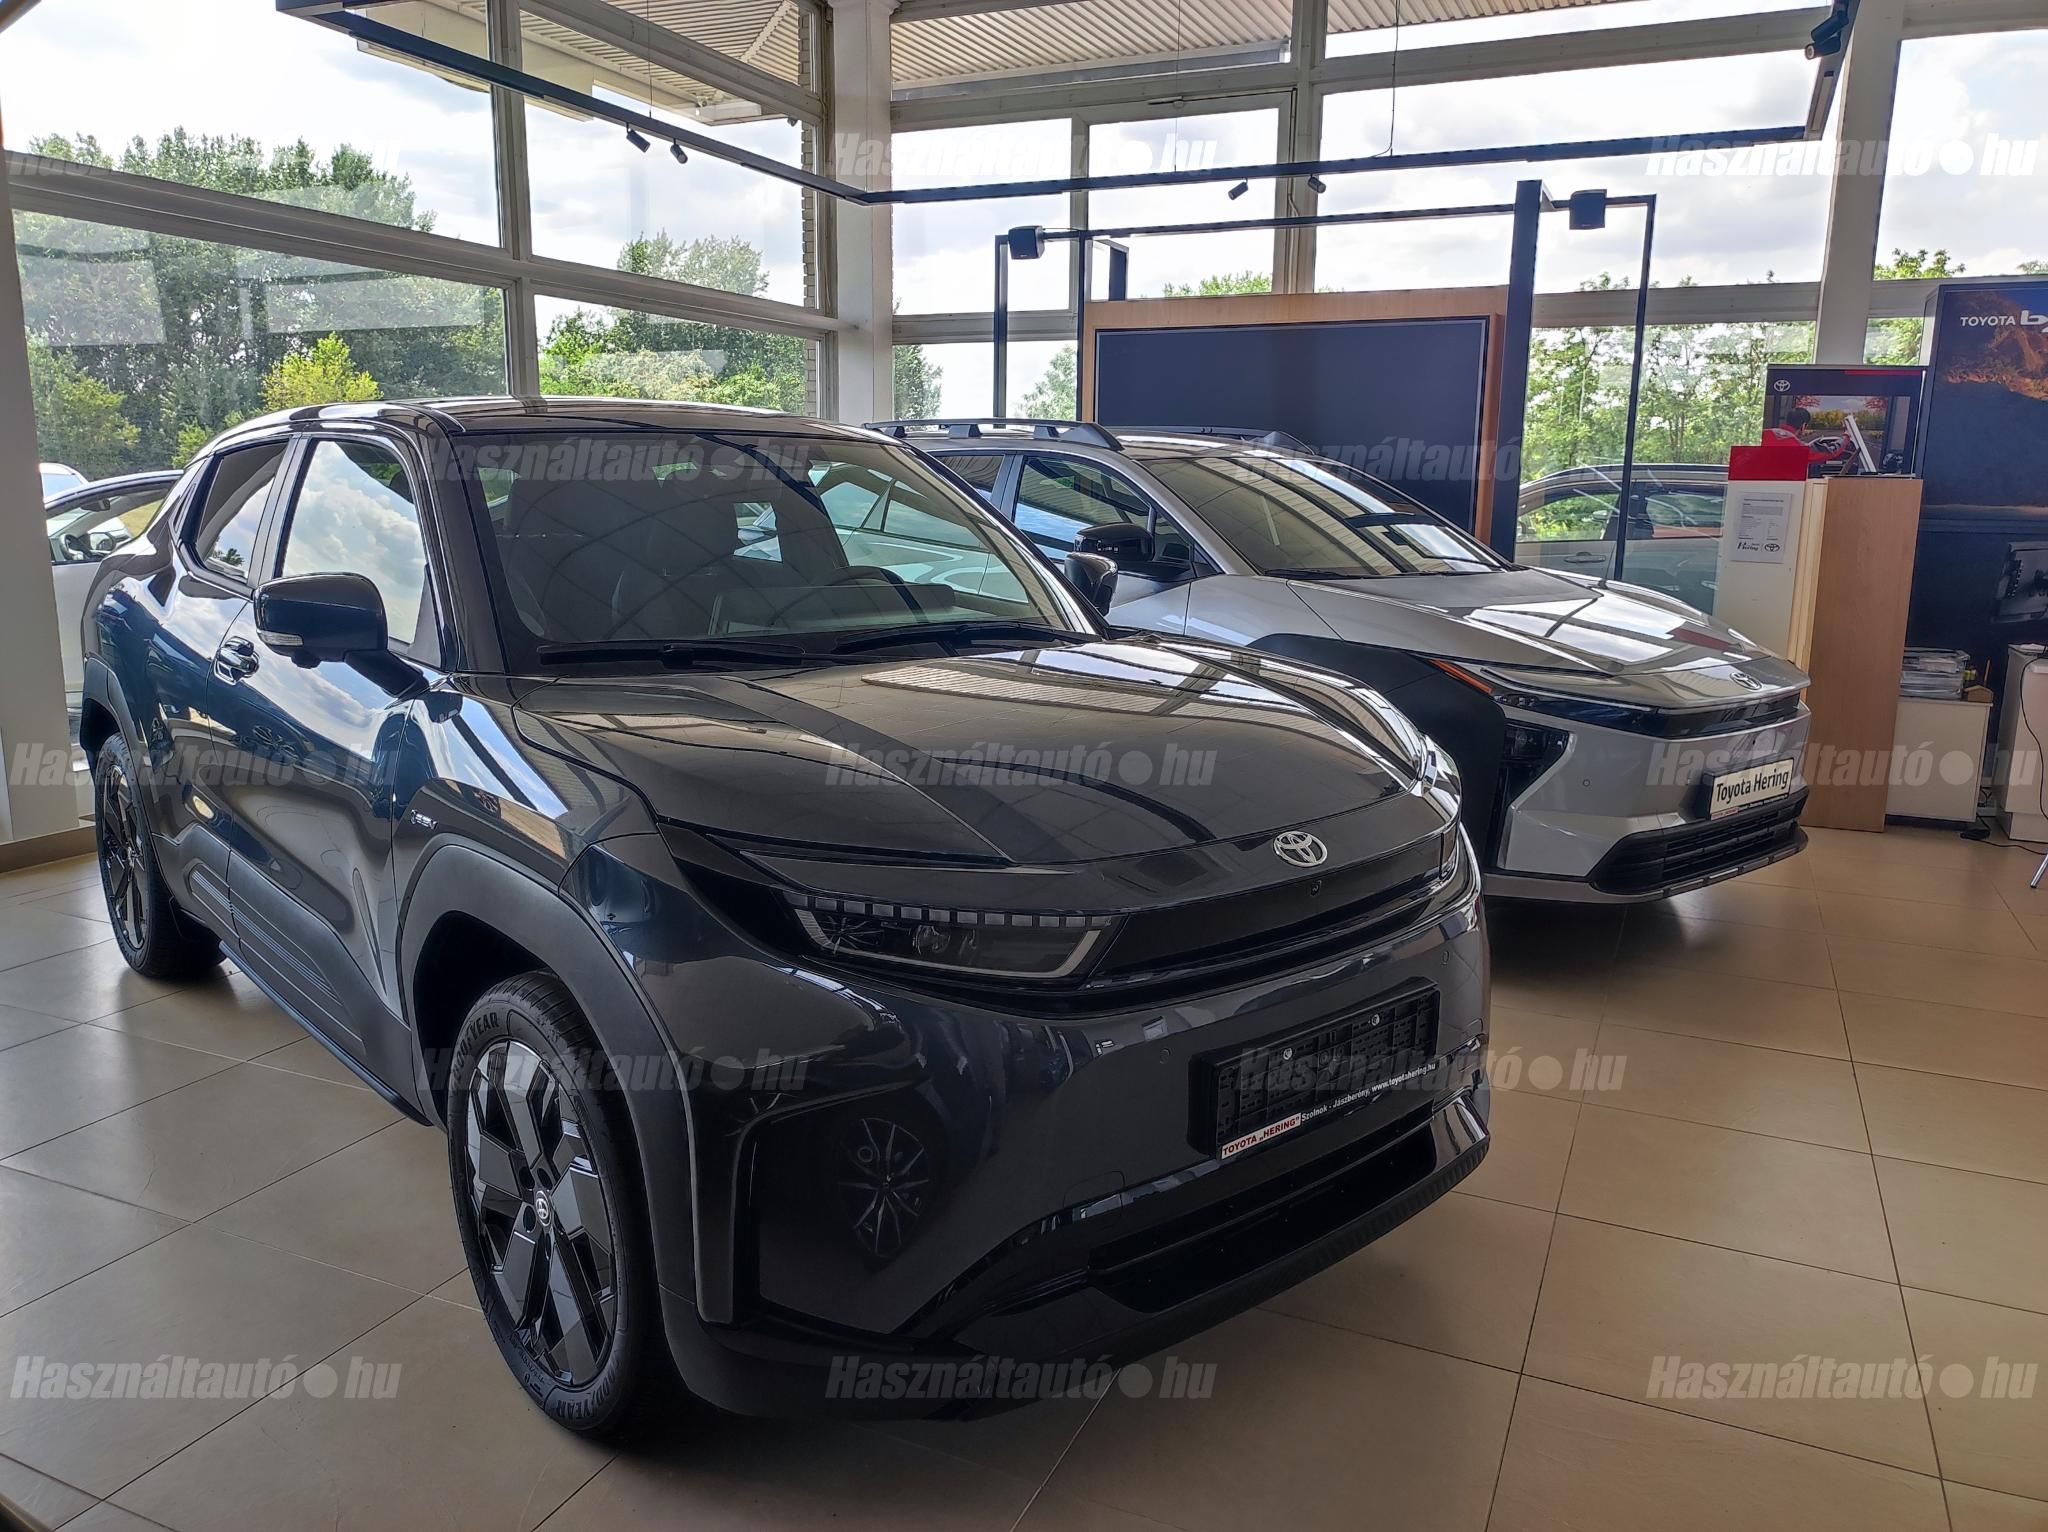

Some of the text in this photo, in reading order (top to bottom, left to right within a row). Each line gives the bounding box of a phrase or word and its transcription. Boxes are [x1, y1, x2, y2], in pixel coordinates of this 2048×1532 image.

[1960, 316, 2016, 327] TOYOTA
[1716, 768, 1789, 805] Toyota Hering
[451, 1011, 500, 1094] OODYEAR
[1223, 1135, 1257, 1156] TOYOTA
[1301, 1104, 1328, 1121] Szolnok
[1371, 1063, 1436, 1093] www.toyotahering.hu
